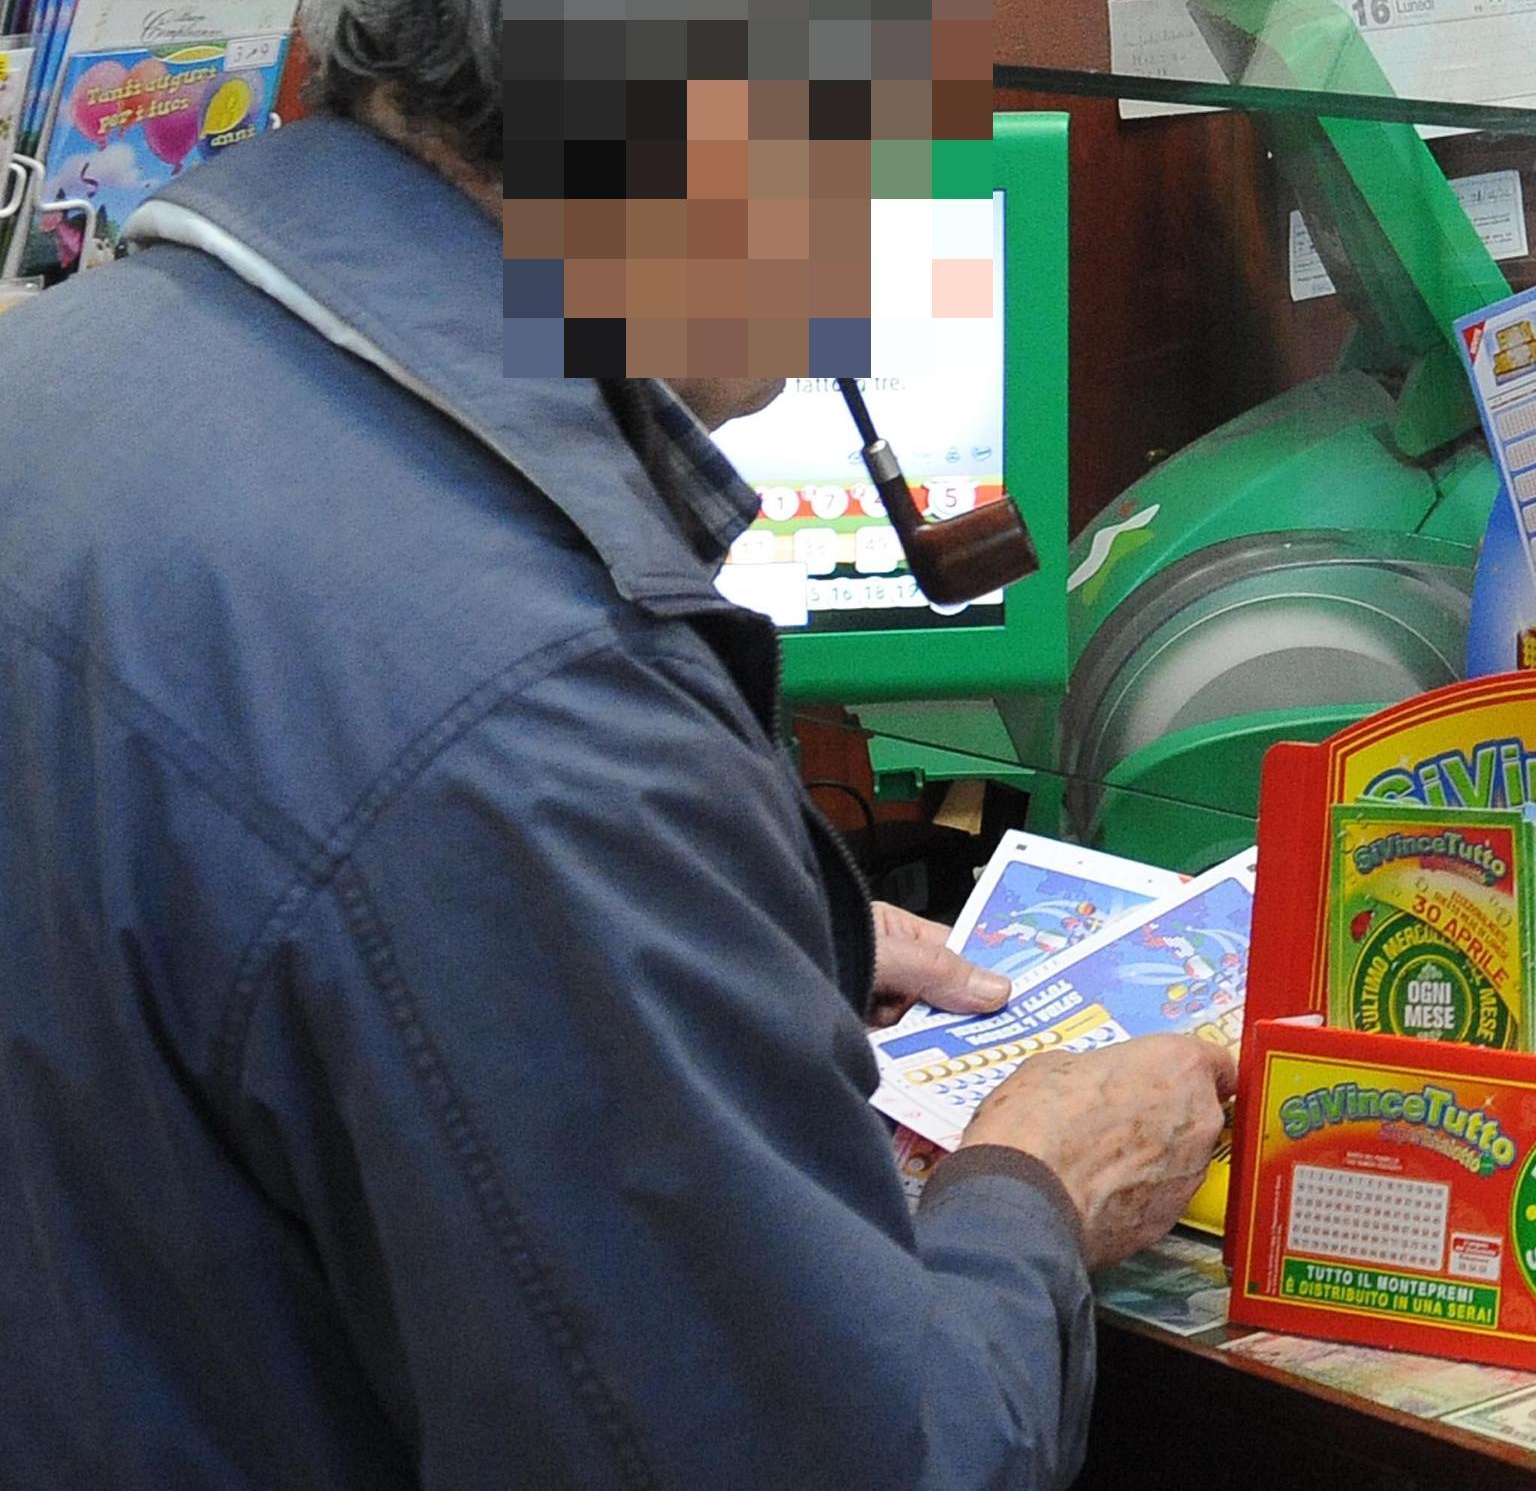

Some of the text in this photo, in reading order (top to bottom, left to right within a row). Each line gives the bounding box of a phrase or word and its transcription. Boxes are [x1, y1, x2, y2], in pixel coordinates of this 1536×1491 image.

[945, 487, 958, 507] 5
[831, 587, 852, 602] 16
[1353, 830, 1507, 876] SiVinceTutto
[1411, 893, 1443, 925] 30
[1443, 920, 1510, 989] APRILE
[1406, 980, 1453, 1005] OGNI
[1403, 1005, 1456, 1030] MESE
[1478, 987, 1498, 1042] MESE
[1279, 1082, 1518, 1170] SiVinceTutto
[1299, 1277, 1389, 1308] DISTRIBUITO
[1392, 1290, 1411, 1311] IN
[1412, 1292, 1443, 1317] UNA
[1306, 1264, 1474, 1304] TUTTO IL MONTEPREMI
